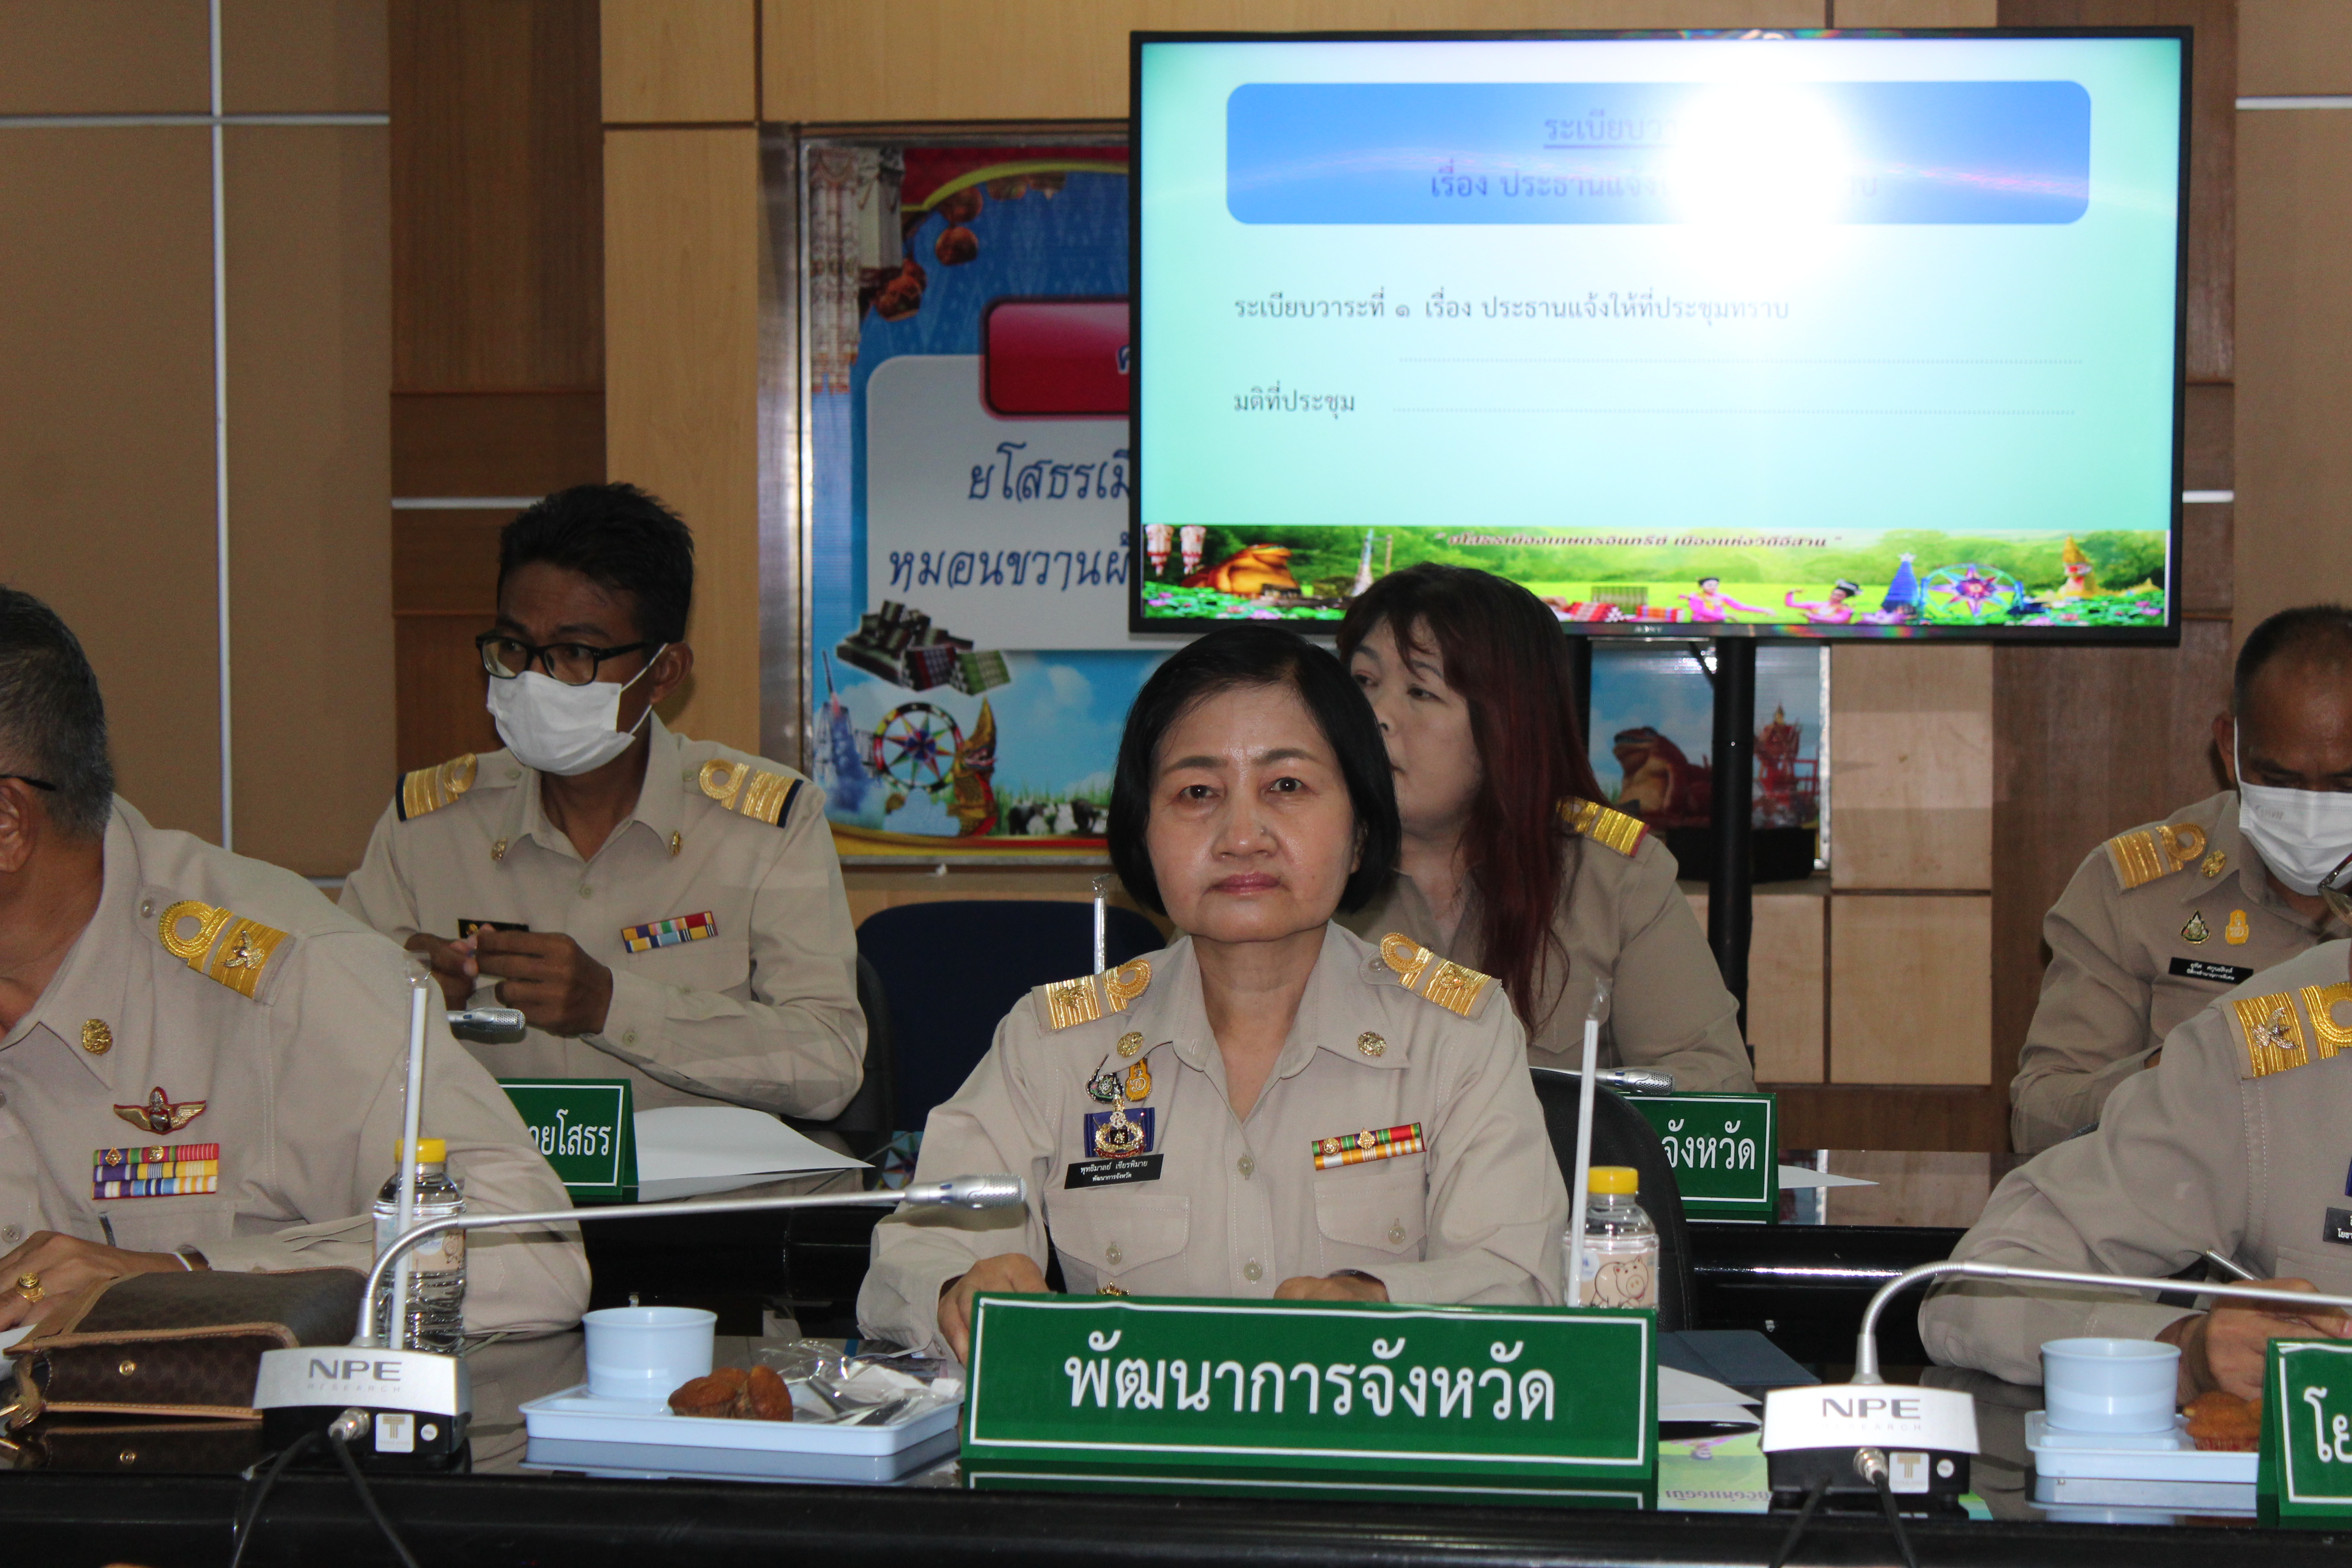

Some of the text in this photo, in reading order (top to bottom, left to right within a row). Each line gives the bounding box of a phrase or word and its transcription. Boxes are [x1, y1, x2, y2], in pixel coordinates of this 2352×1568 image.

[1431, 158, 1487, 198] เรื่อง
[1234, 287, 1790, 326] ระเบียบวาระที่ ๑ เรื่อง ประธานแจ้งให้ที่ประชุมทราบ
[1233, 382, 1355, 419] มติที่ประชุม
[309, 1359, 402, 1382] NPE
[1064, 1329, 1556, 1421] พัฒนาการจังหวัด
[1822, 1398, 1921, 1419] NPE
